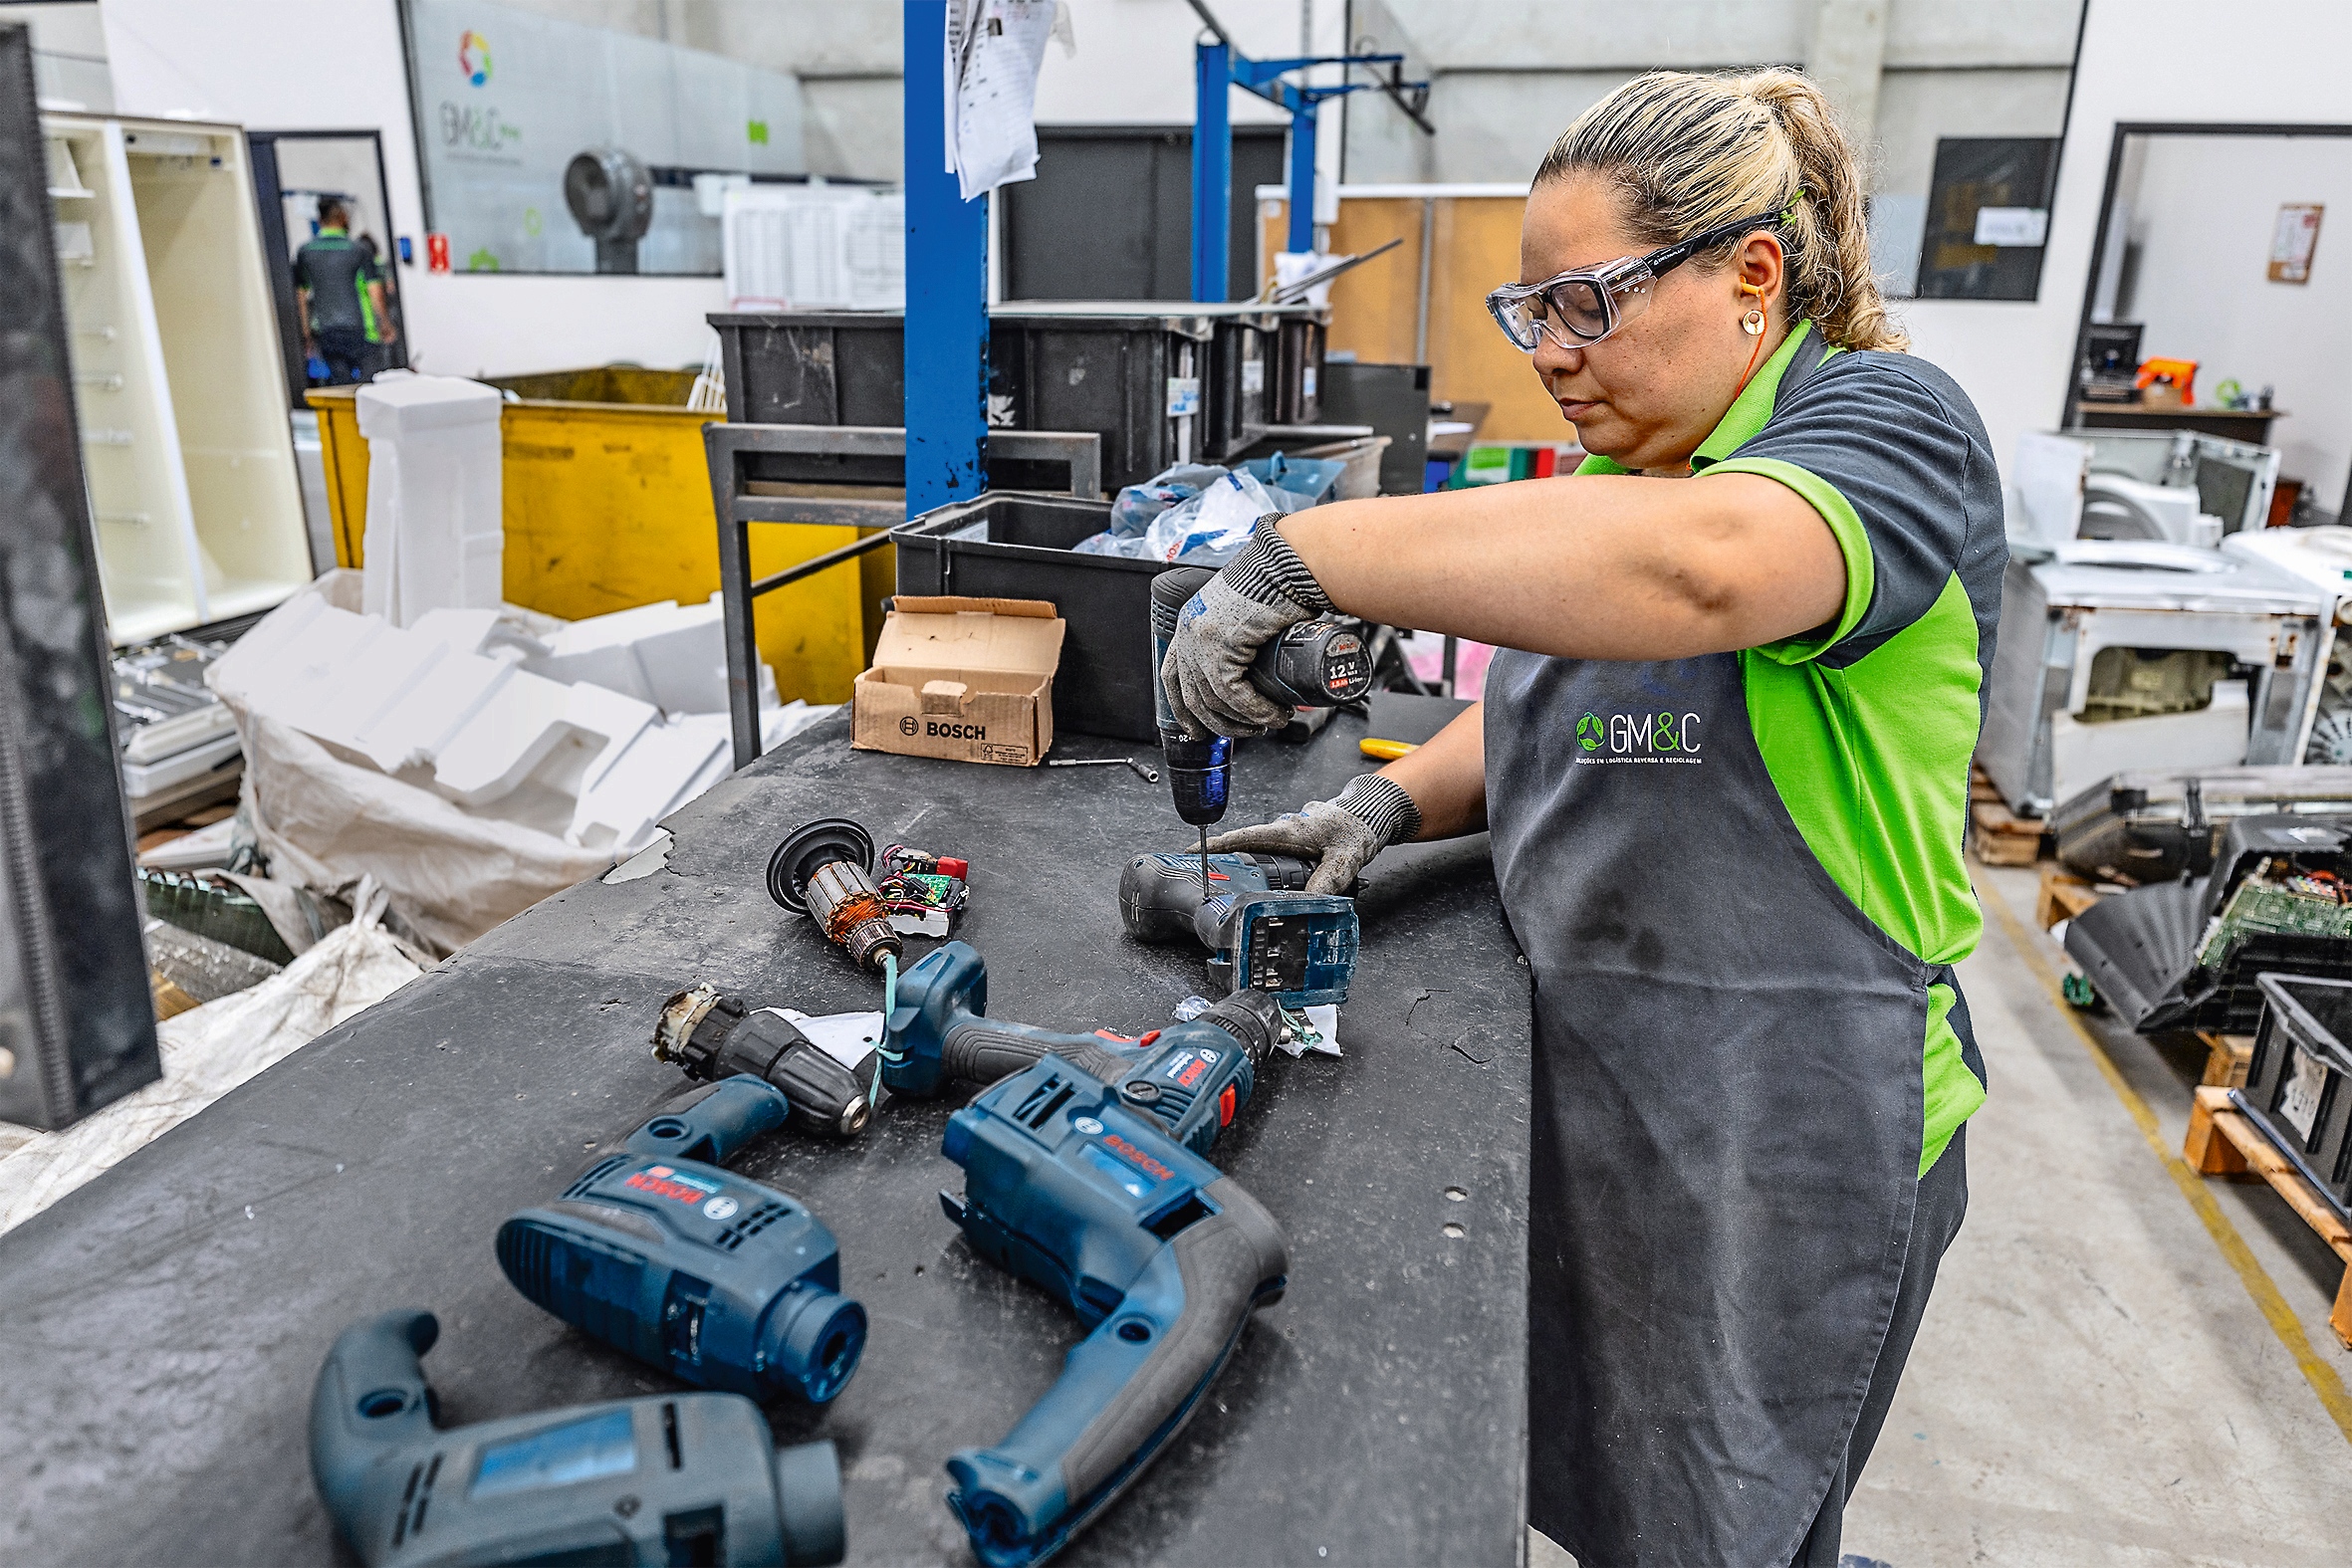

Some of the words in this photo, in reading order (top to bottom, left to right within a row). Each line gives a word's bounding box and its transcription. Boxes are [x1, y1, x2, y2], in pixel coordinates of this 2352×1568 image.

[1329, 665, 1347, 680] 12
[1348, 661, 1355, 670] V
[927, 722, 986, 741] BOSCH
[1610, 712, 1702, 754] GM&C
[1177, 1058, 1207, 1088] BOSCH
[1103, 1134, 1175, 1181] BOSCH
[624, 1172, 705, 1206] BOSCH
